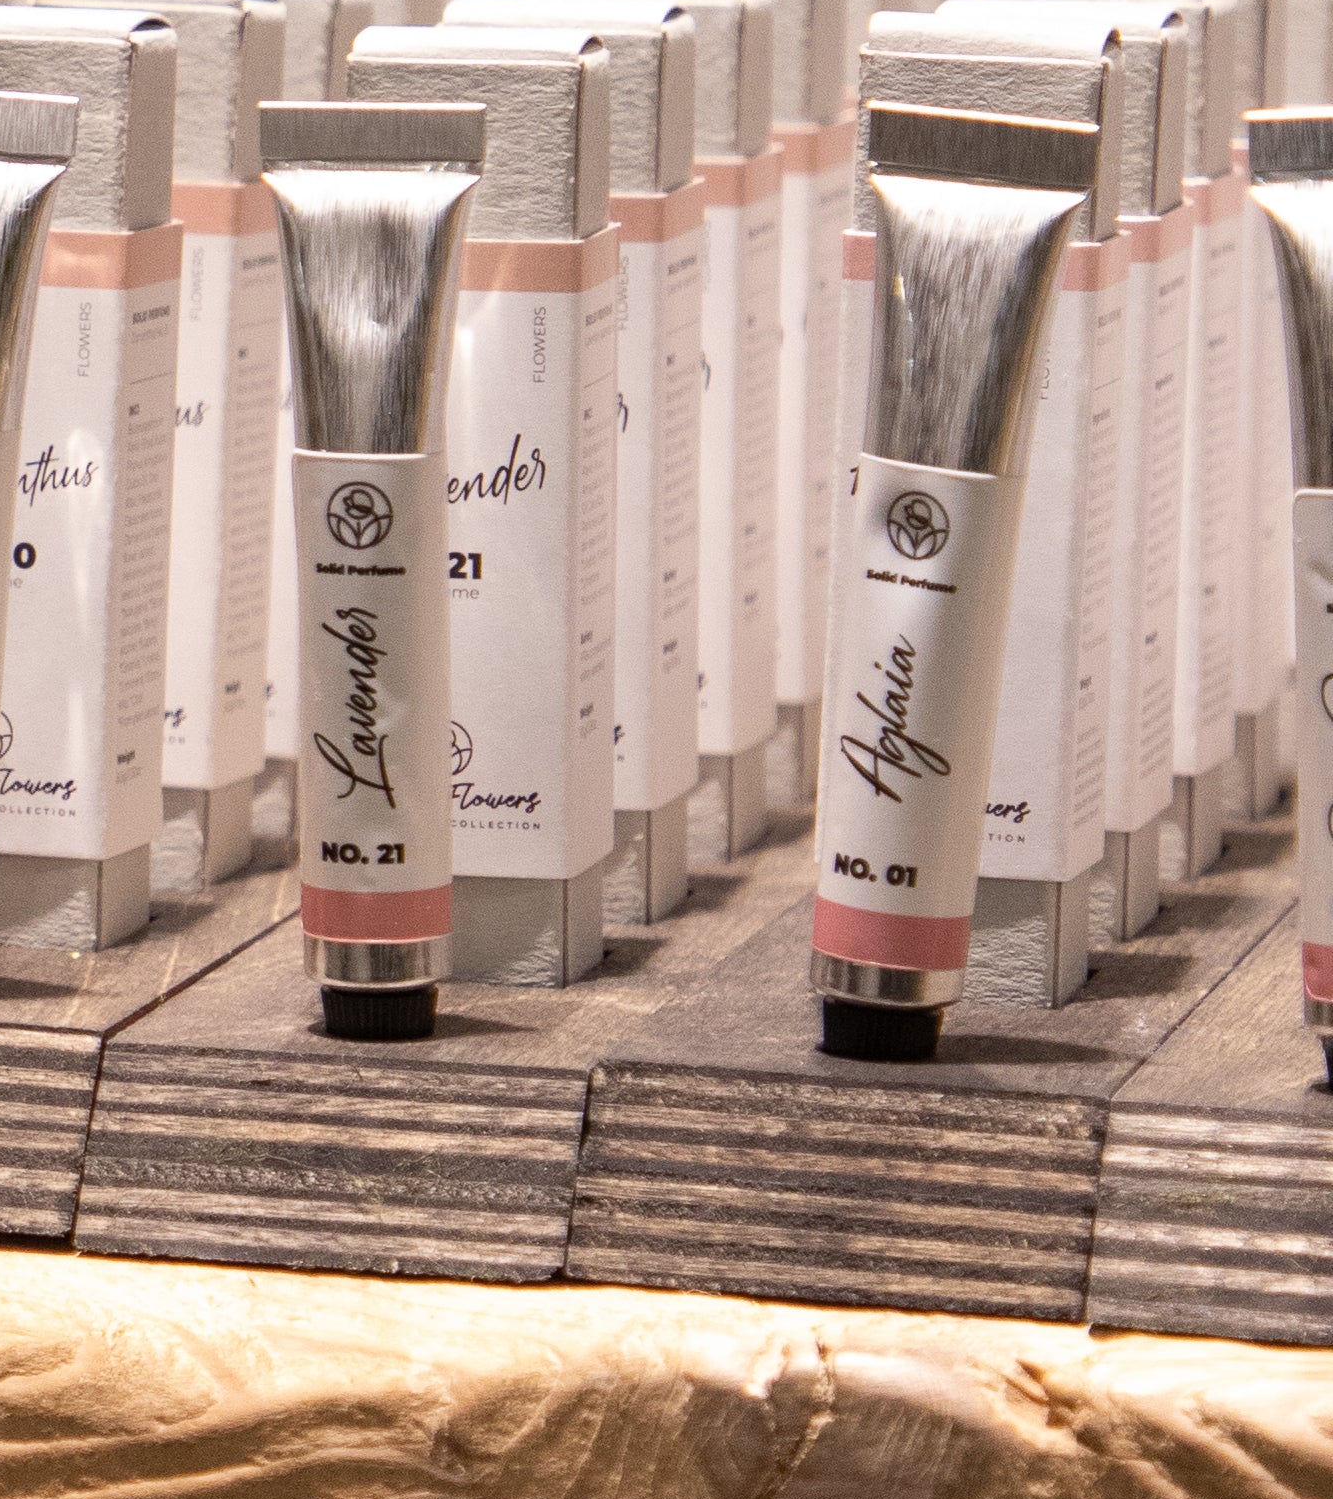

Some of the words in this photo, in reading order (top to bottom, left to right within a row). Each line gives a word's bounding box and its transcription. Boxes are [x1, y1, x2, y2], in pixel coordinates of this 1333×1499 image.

[77, 300, 93, 378] FLOWERS
[531, 304, 547, 384] FLOWERS
[18, 443, 101, 508] nthus
[448, 434, 547, 506] ender
[13, 541, 37, 570] 0
[316, 562, 344, 576] Solid
[347, 563, 407, 577] Perfume
[448, 552, 483, 581] 21
[866, 568, 898, 585] Solid
[900, 574, 958, 595] Perfume
[313, 606, 397, 810] Lavender
[840, 633, 952, 805] Aglaia
[320, 840, 370, 865] NO.
[376, 842, 406, 865] 21
[833, 852, 878, 884] NO.
[886, 863, 920, 889] 01
